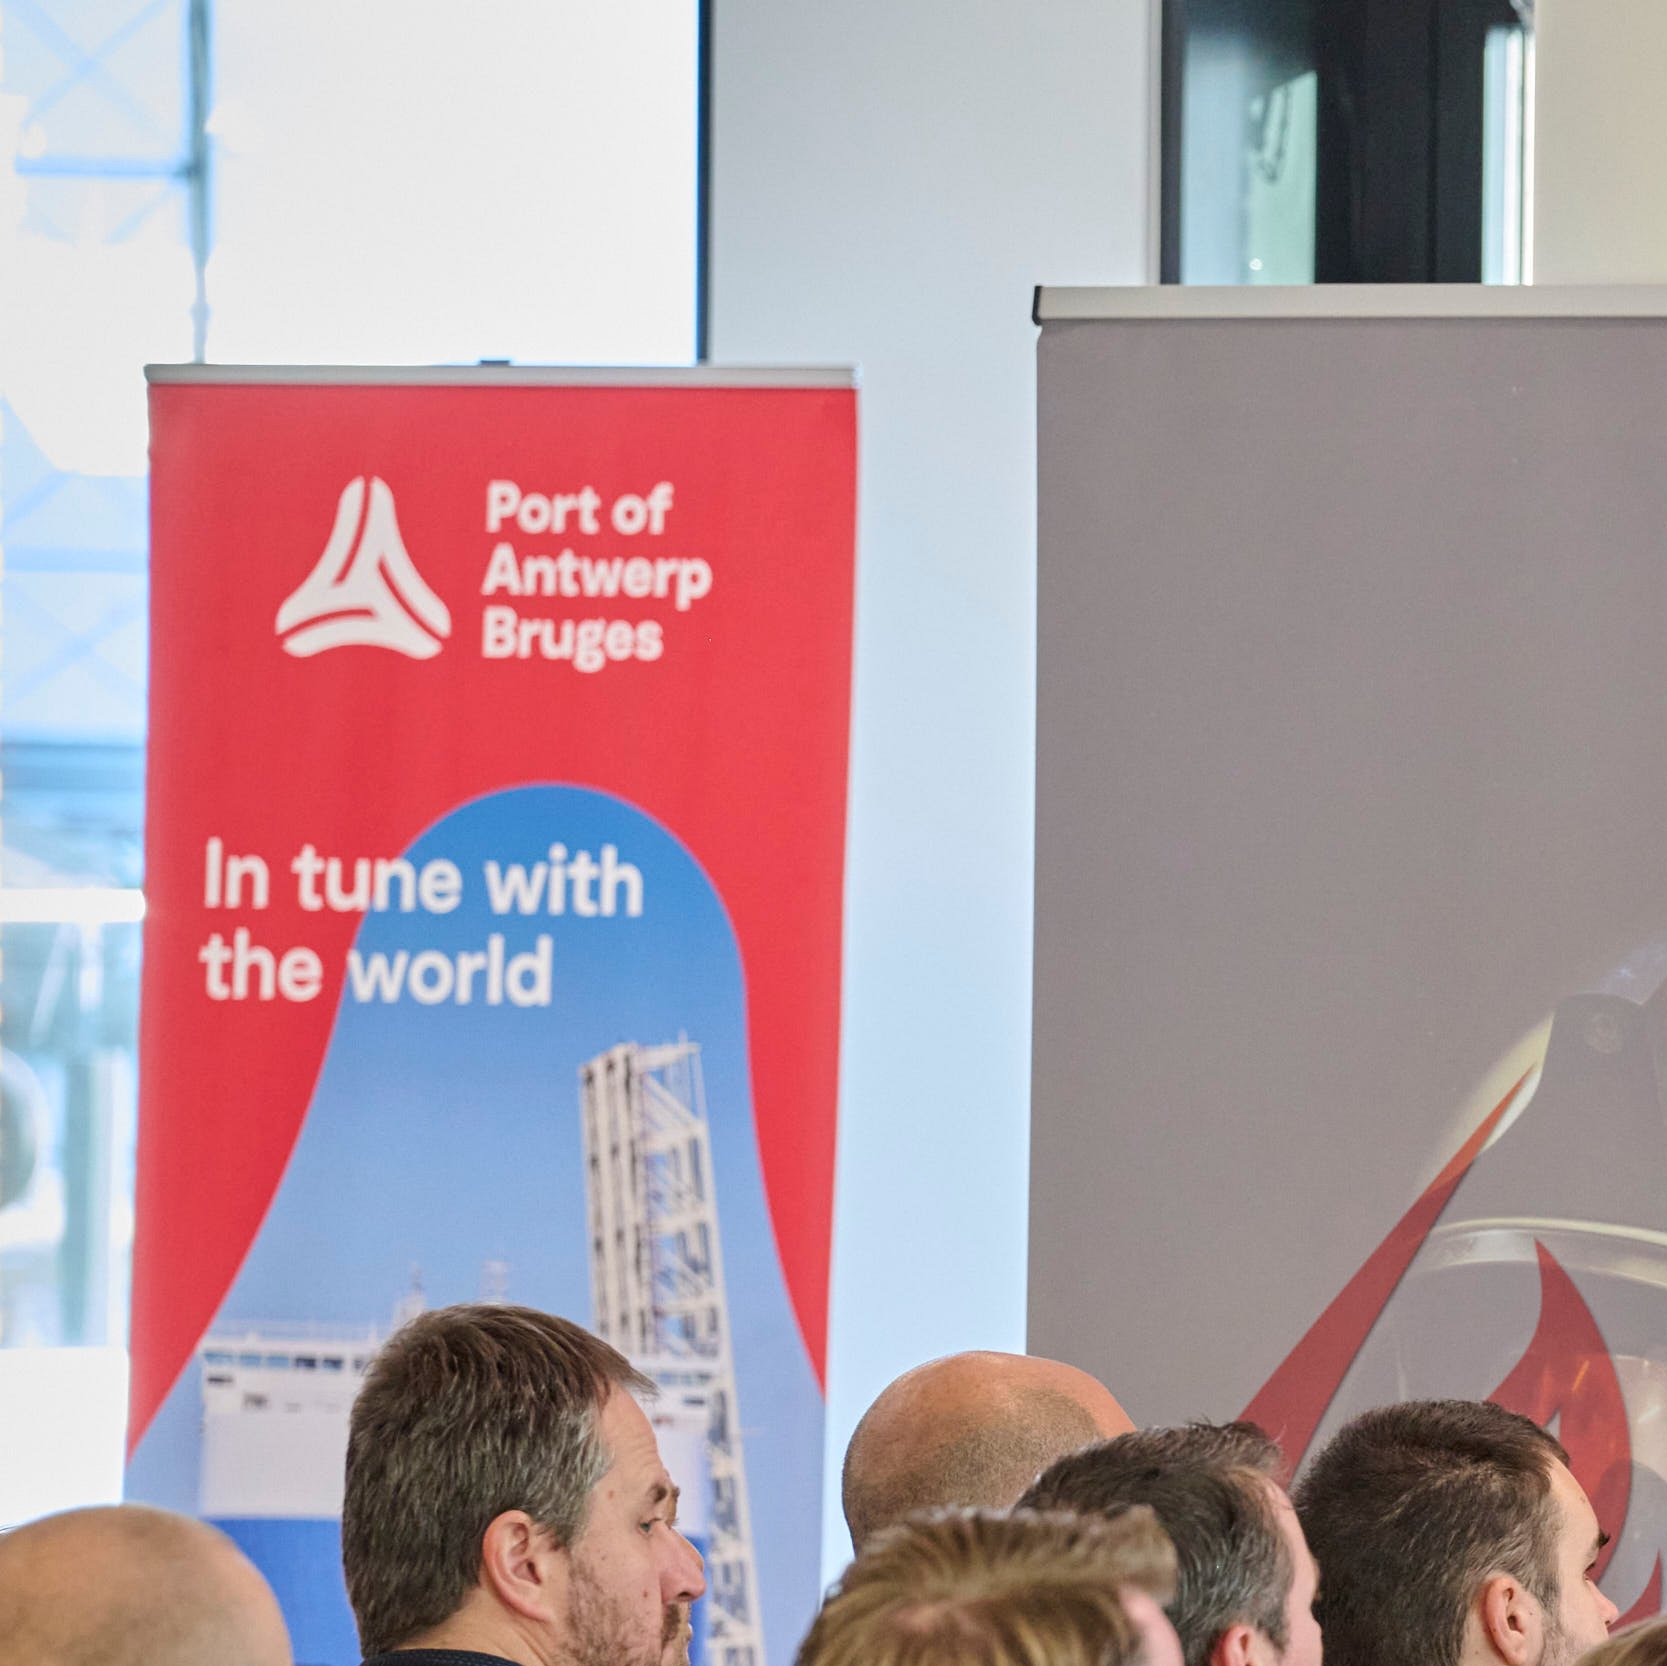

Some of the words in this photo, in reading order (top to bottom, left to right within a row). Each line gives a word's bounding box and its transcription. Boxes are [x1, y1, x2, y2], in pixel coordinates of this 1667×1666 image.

[486, 480, 601, 535] Port
[611, 482, 674, 535] of
[482, 543, 713, 612] Antwerp
[482, 606, 666, 673] Bruges
[205, 837, 269, 909] In
[291, 845, 463, 914] tune
[485, 843, 644, 917] with
[199, 928, 323, 1001] the
[346, 933, 554, 1007] world
